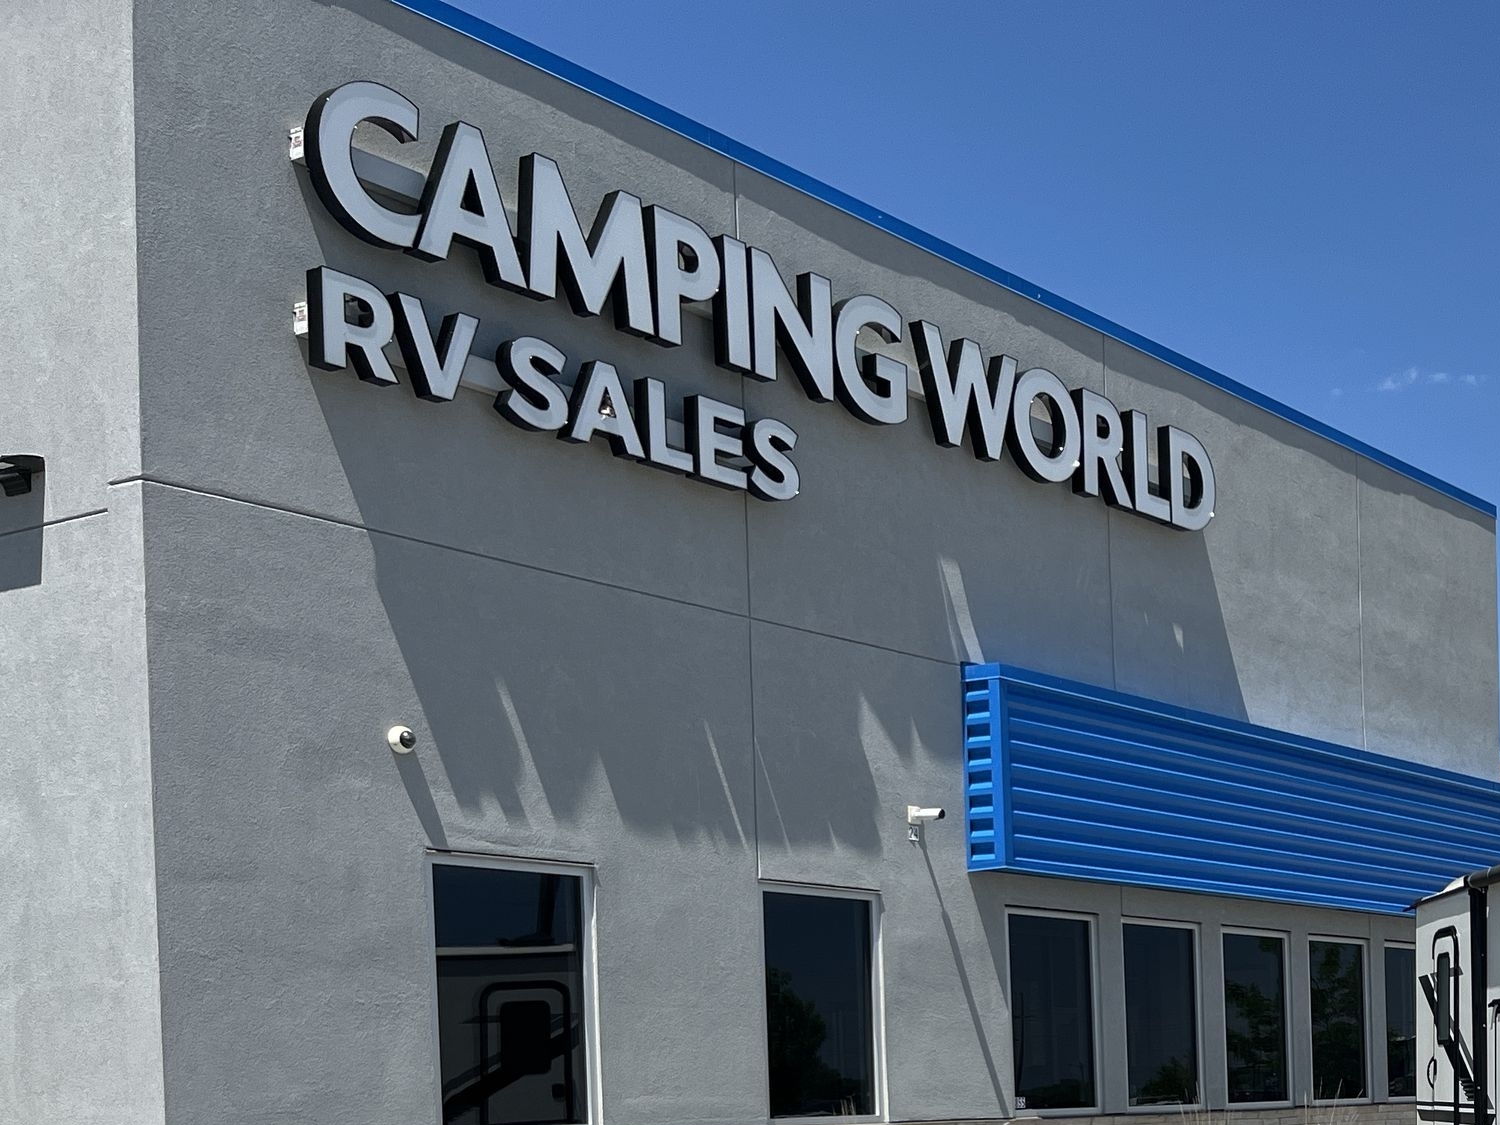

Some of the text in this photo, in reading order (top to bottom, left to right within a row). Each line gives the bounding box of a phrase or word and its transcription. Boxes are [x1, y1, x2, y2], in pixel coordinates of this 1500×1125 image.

[306, 80, 1217, 531] CAMPING WORLD
[306, 265, 800, 500] RV SALES
